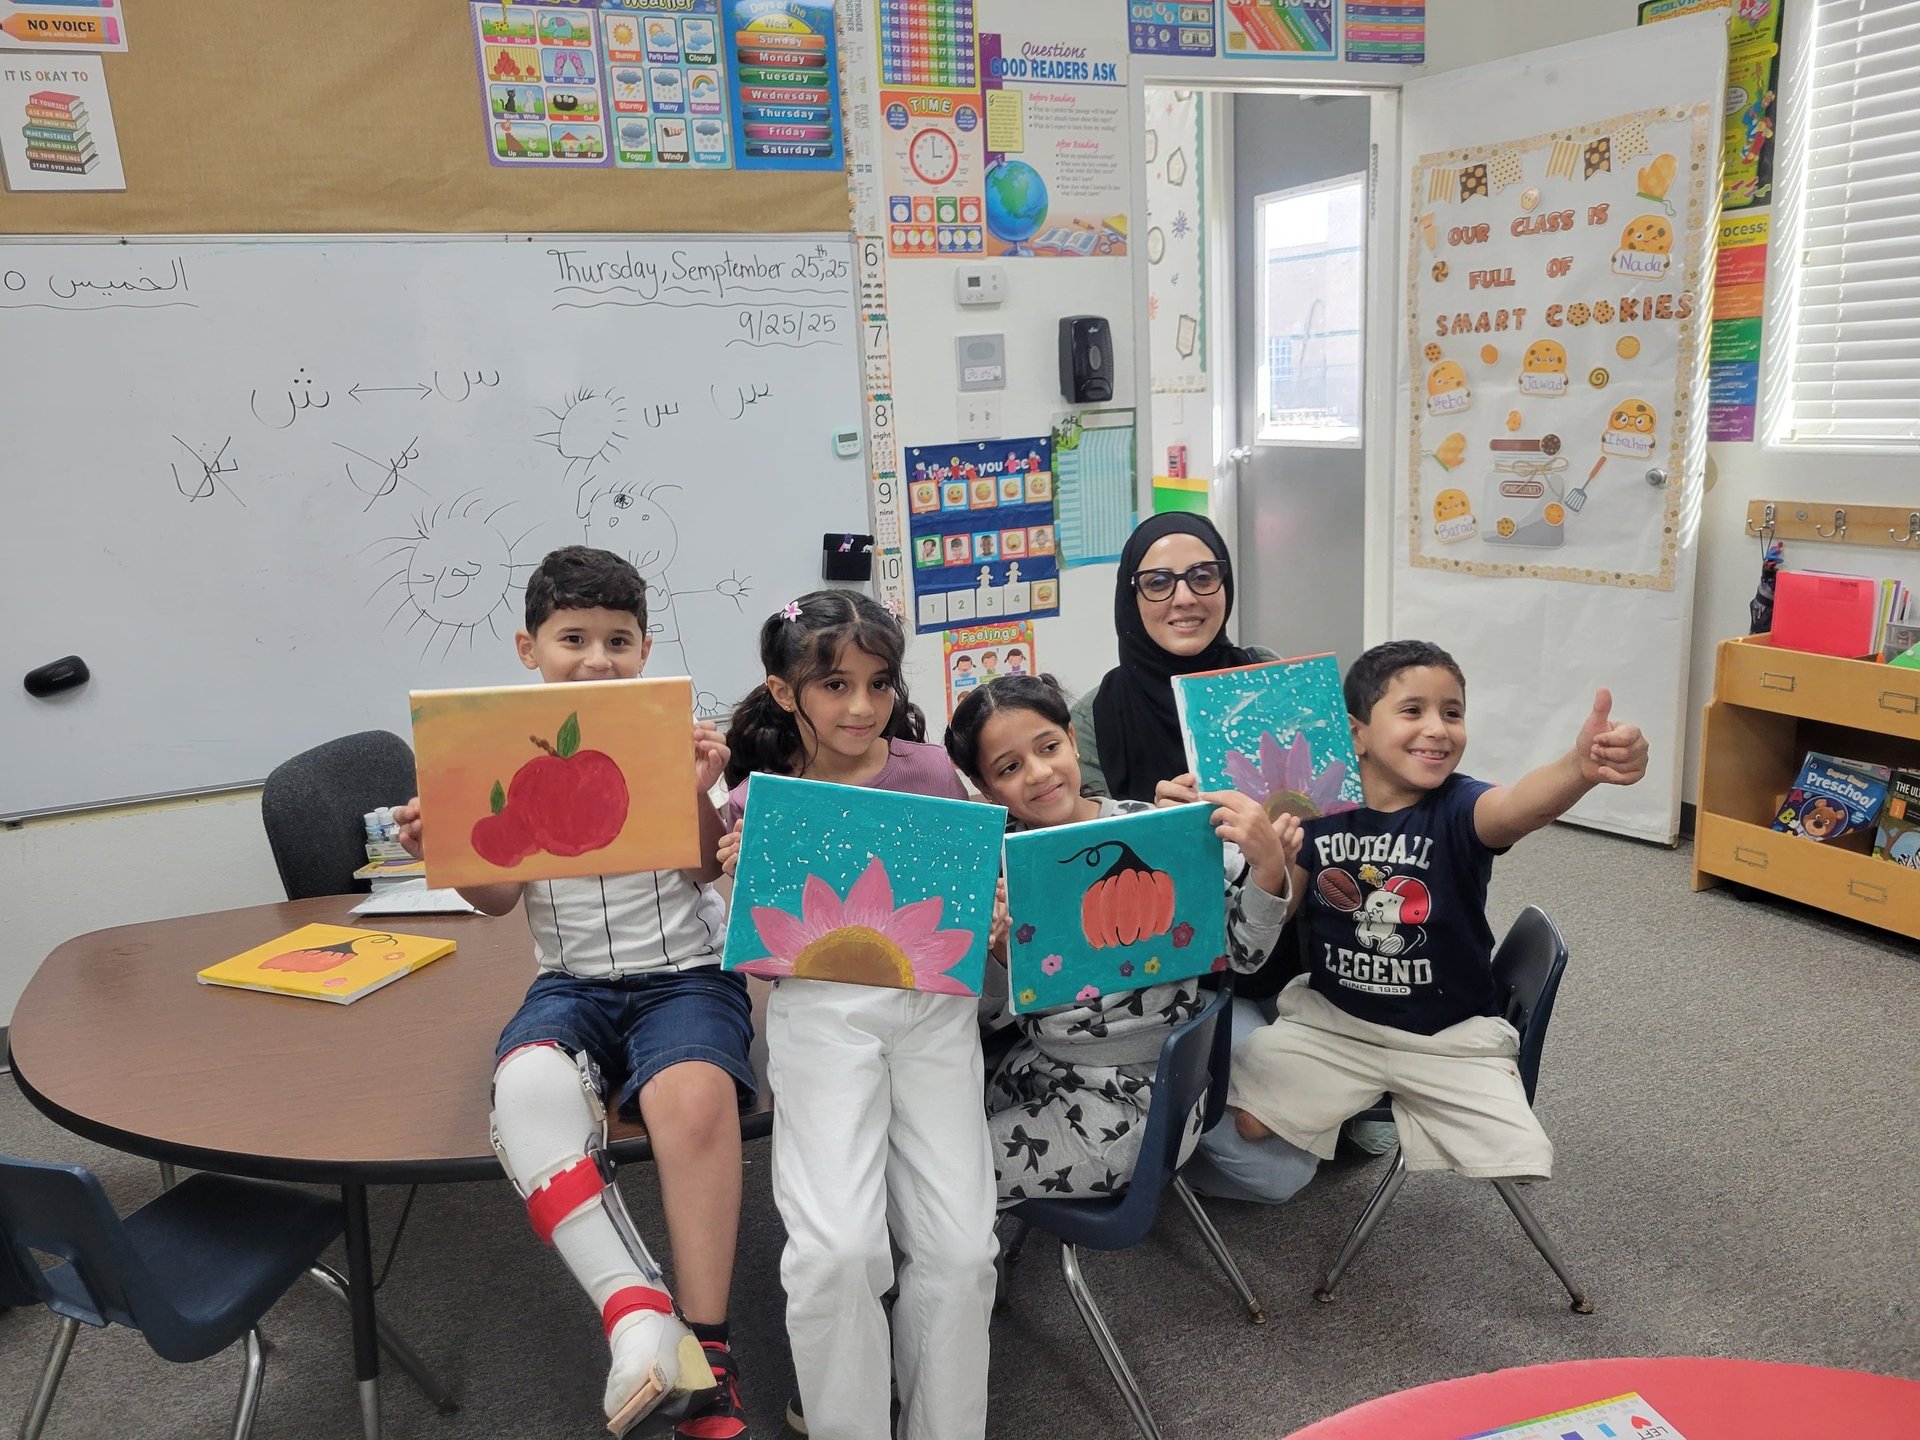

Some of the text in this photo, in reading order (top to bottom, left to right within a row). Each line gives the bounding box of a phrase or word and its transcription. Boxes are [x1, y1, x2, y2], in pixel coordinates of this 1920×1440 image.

[750, 1, 775, 13] Days
[790, 3, 806, 18] the
[28, 20, 96, 32] NO VOICE
[764, 18, 794, 30] Week
[1284, 16, 1305, 44] Thousands
[1314, 18, 1324, 32] Tens
[758, 34, 802, 46] Sunday
[615, 52, 636, 60] Sunny
[688, 54, 712, 63] Cloudy
[759, 52, 806, 64] Monday
[1020, 41, 1087, 62] Questions
[4, 70, 88, 82] IT IS OKAY TO
[990, 57, 1117, 81] GOOD READERS ASK
[758, 71, 809, 83] Tuesday
[751, 90, 818, 102] Wednesday
[40, 100, 68, 110] YOURSELF
[619, 102, 644, 110] Stormy
[660, 103, 678, 112] Rainy
[691, 104, 720, 112] Rainbow
[909, 97, 952, 114] TIME
[758, 108, 814, 120] Thursday
[44, 132, 70, 140] MISTAKES
[769, 126, 806, 138] Friday
[626, 152, 647, 162] Foggy
[663, 152, 684, 162] Windy
[762, 144, 816, 156] Saturday
[700, 154, 721, 162] Snowy
[856, 164, 864, 173] ER
[864, 164, 872, 174] ER
[1448, 202, 1610, 247] OUR CLASS IS
[864, 243, 878, 266] 6
[1620, 253, 1663, 272] Nada
[49, 256, 189, 298] الخميس
[868, 272, 878, 280] six
[1469, 256, 1574, 290] FULL OF
[1435, 307, 1526, 337] SMART
[1545, 290, 1694, 328] COOKIES
[738, 310, 837, 342] 9/25/25
[868, 325, 882, 348] 7
[1524, 376, 1564, 392] Jawad
[875, 404, 888, 427] 8
[873, 431, 892, 440] eight
[978, 462, 1004, 476] you
[878, 482, 892, 504] 9
[880, 508, 894, 516] nine
[882, 558, 900, 580] 10
[886, 584, 898, 592] ten
[958, 600, 964, 610] 2
[986, 596, 993, 606] 3
[1013, 594, 1020, 603] 4
[960, 627, 1018, 643] Feelings
[1806, 772, 1878, 809] Preschool
[1896, 780, 1910, 794] THE
[1779, 808, 1796, 824] B
[1314, 832, 1434, 870] FOOTBALL
[1324, 942, 1432, 984] LEGEND
[1341, 980, 1408, 994] SINCE 1950
[1637, 1426, 1668, 1440] LEFT
